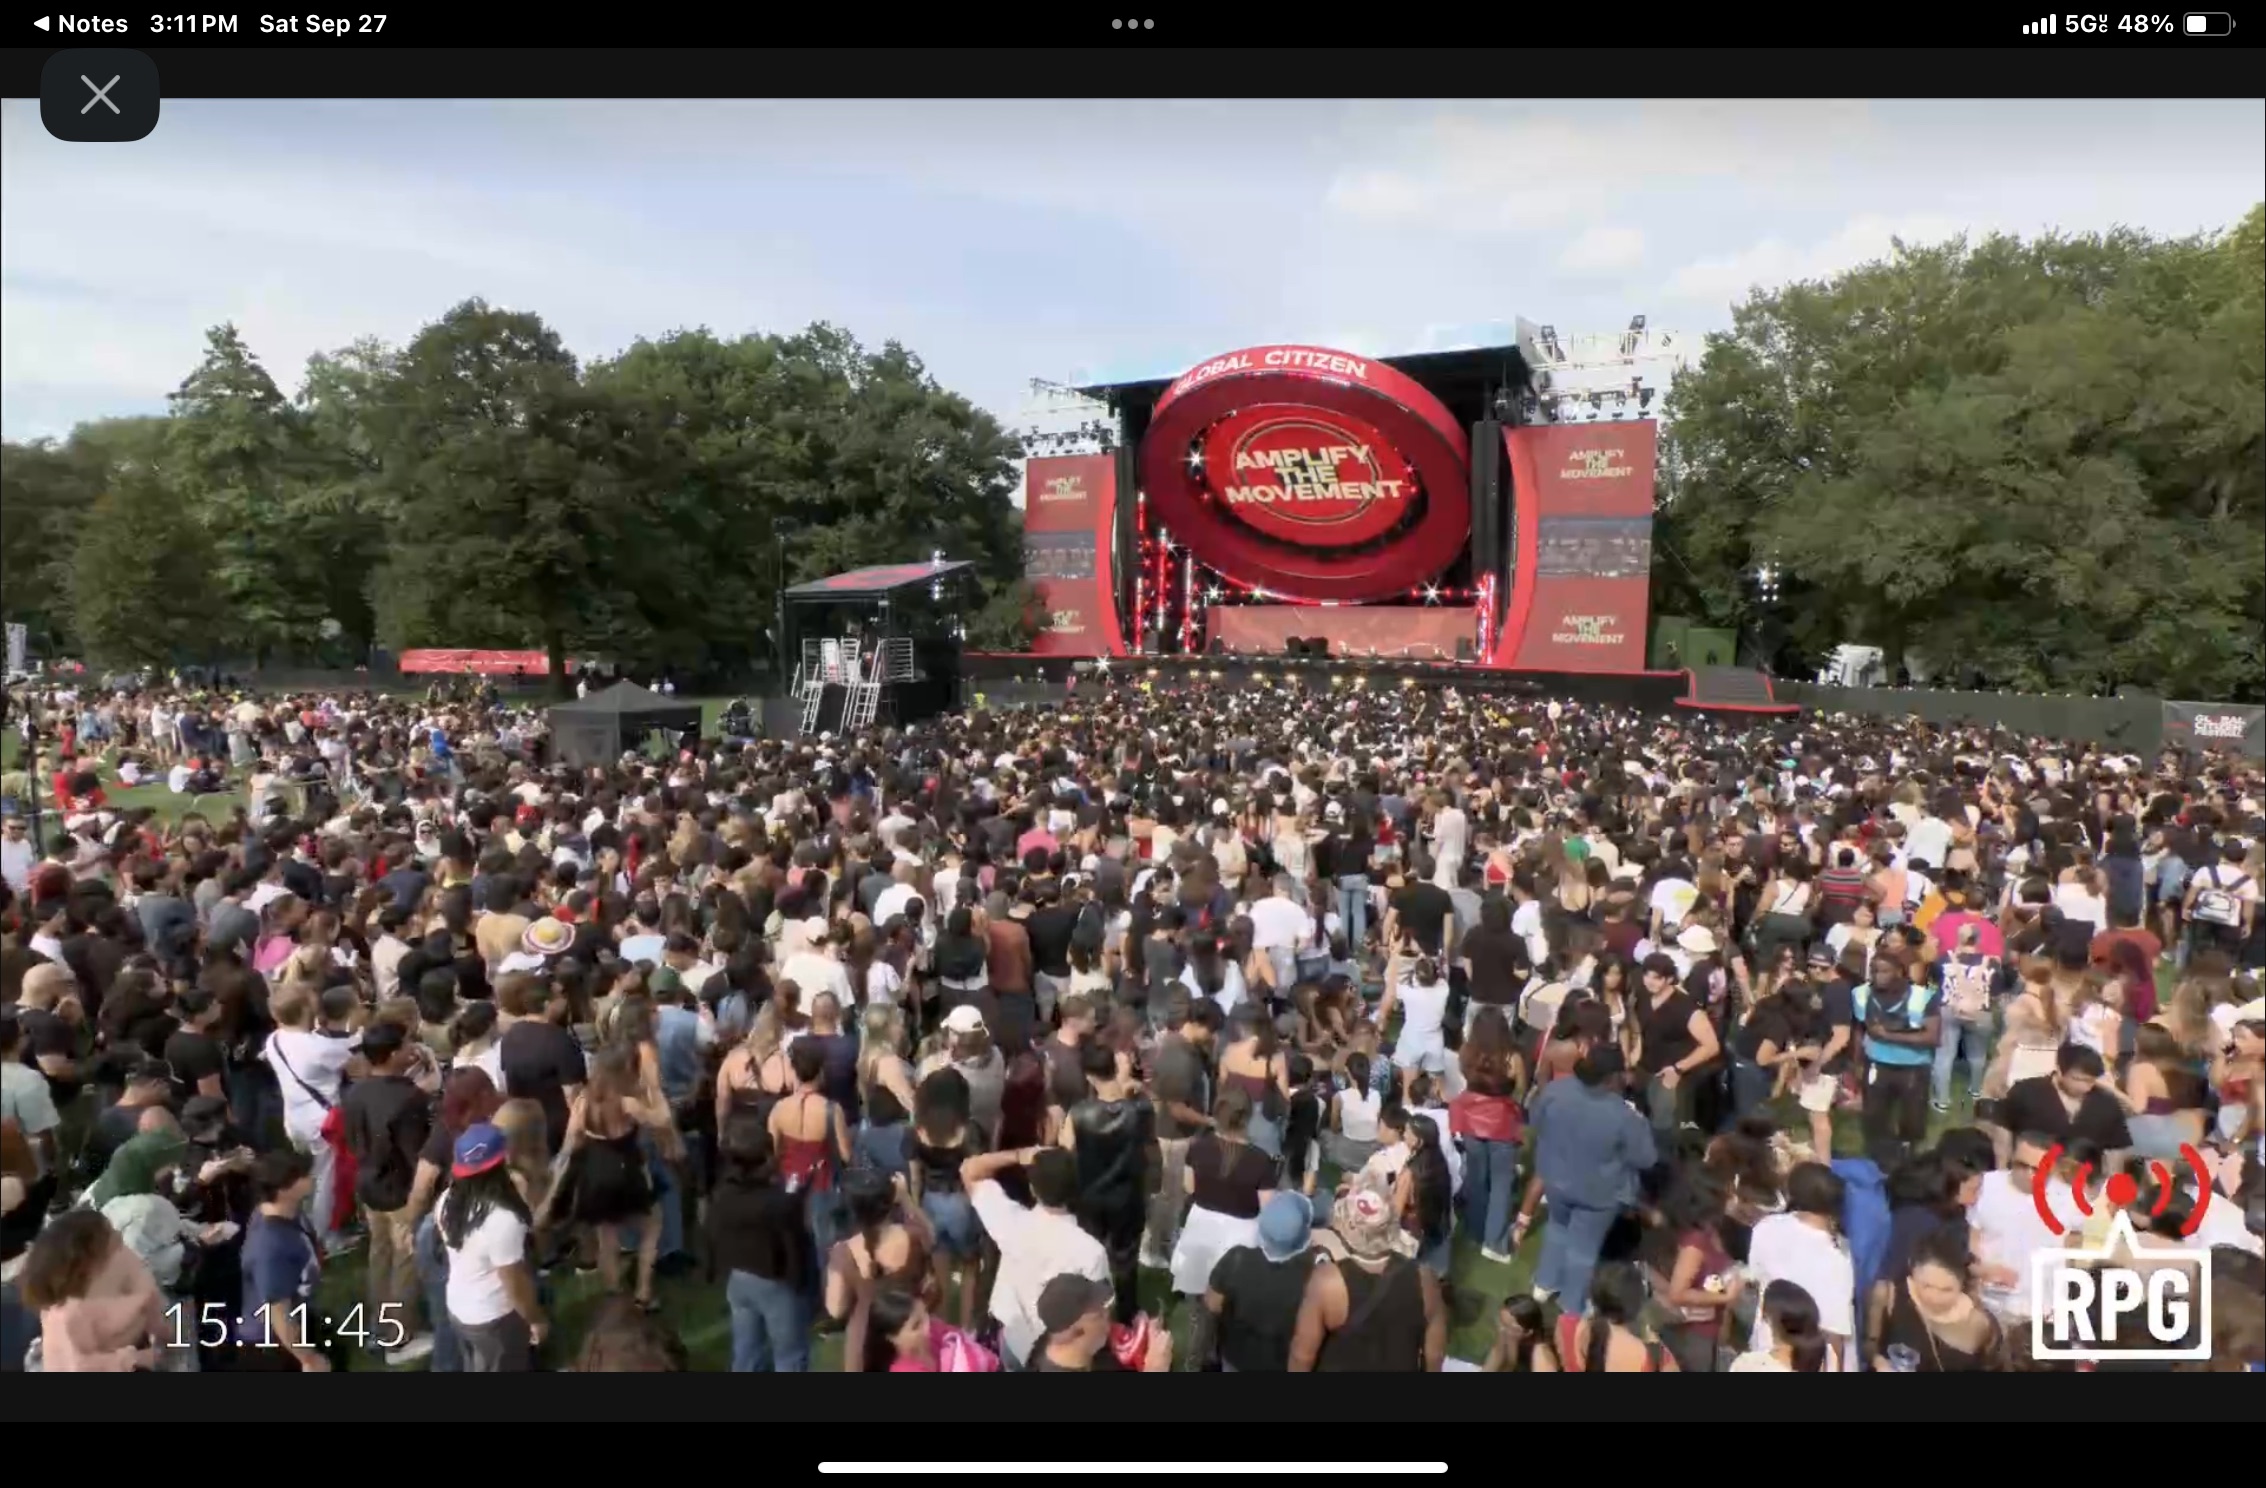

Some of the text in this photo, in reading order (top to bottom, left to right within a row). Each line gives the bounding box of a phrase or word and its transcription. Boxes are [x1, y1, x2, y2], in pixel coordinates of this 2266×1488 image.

[1172, 349, 1367, 396] GLOBAL CITIZEN
[1236, 445, 1370, 469] AMPLIFY
[1568, 449, 1625, 462] AMPLIFY
[1275, 465, 1337, 484] THE
[1559, 466, 1634, 479] MOVEMENT
[1225, 480, 1403, 504] MOVEMENT
